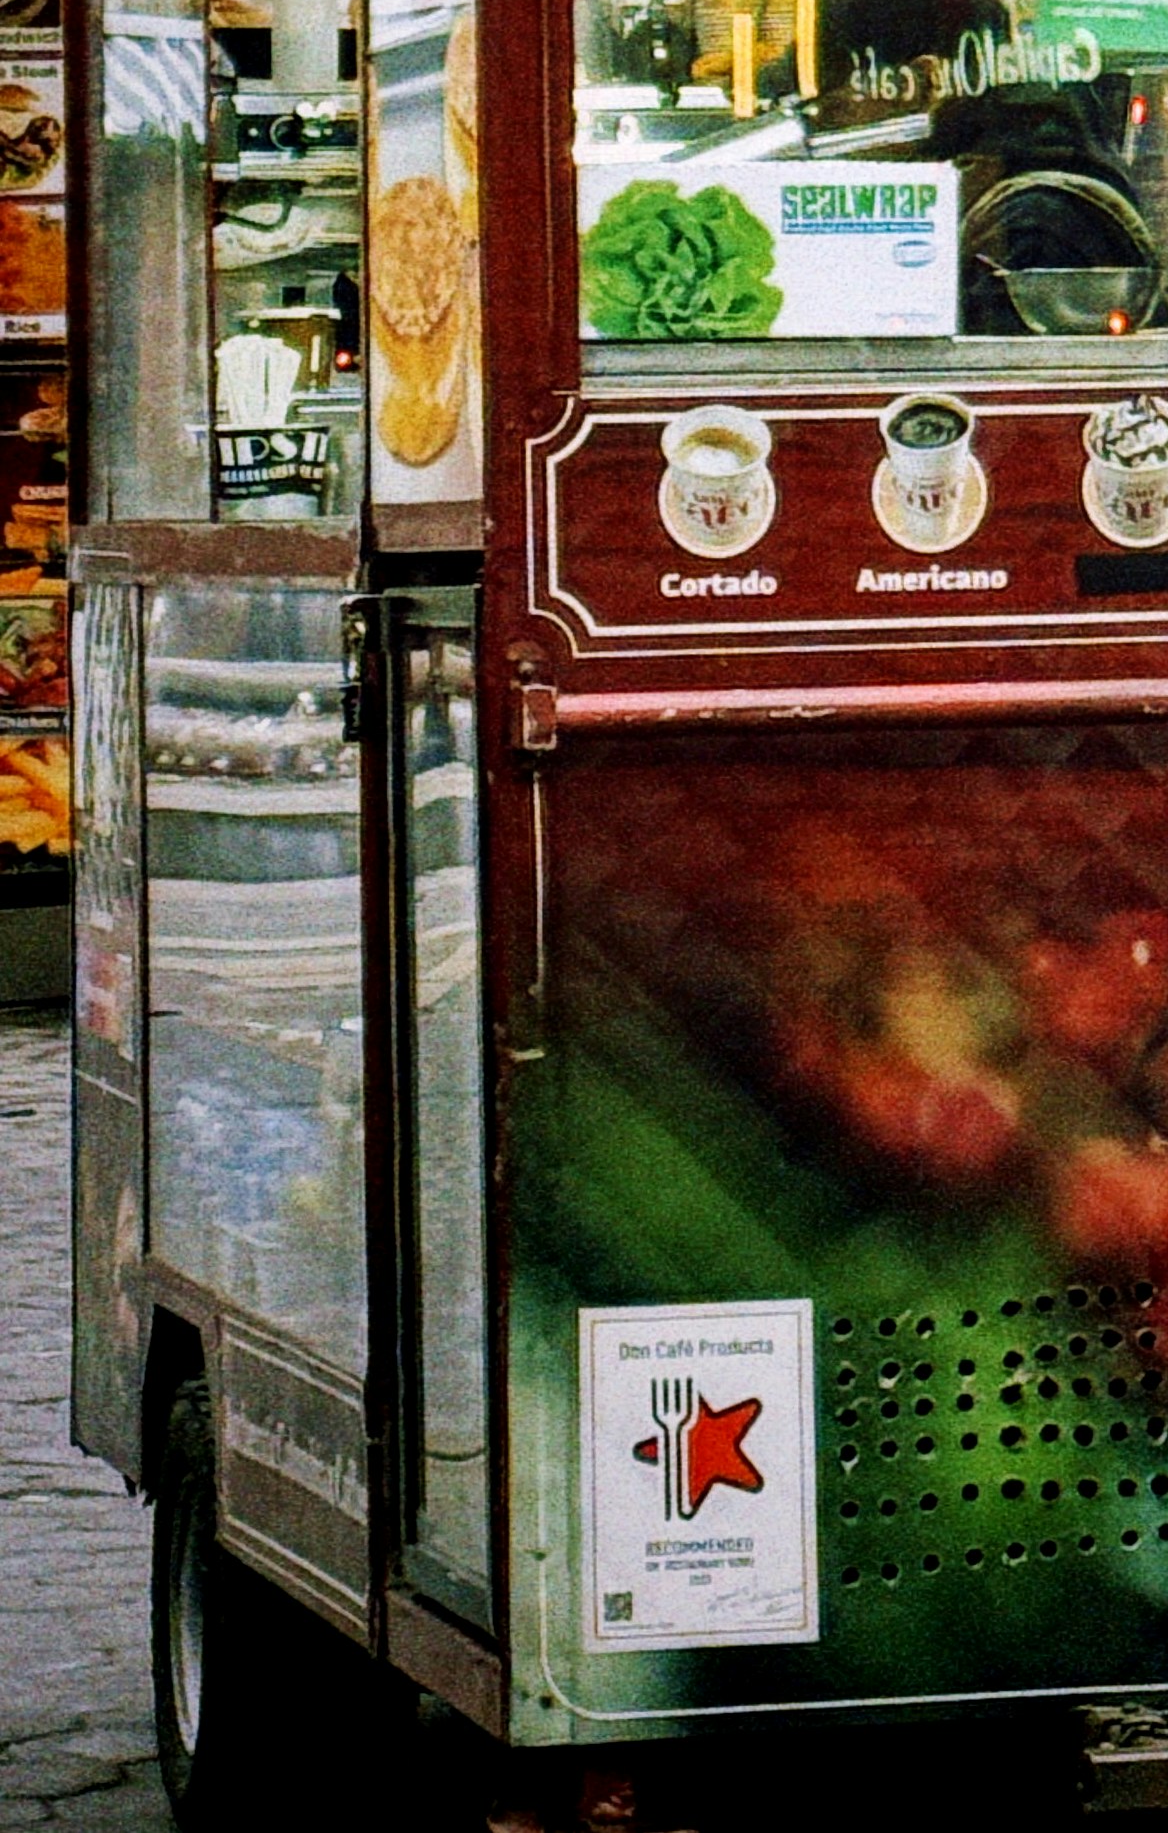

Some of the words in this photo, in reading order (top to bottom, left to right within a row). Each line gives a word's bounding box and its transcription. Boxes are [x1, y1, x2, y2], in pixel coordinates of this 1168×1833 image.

[660, 570, 778, 597] Cortado
[856, 564, 1008, 594] Americano
[619, 1342, 650, 1360] Don
